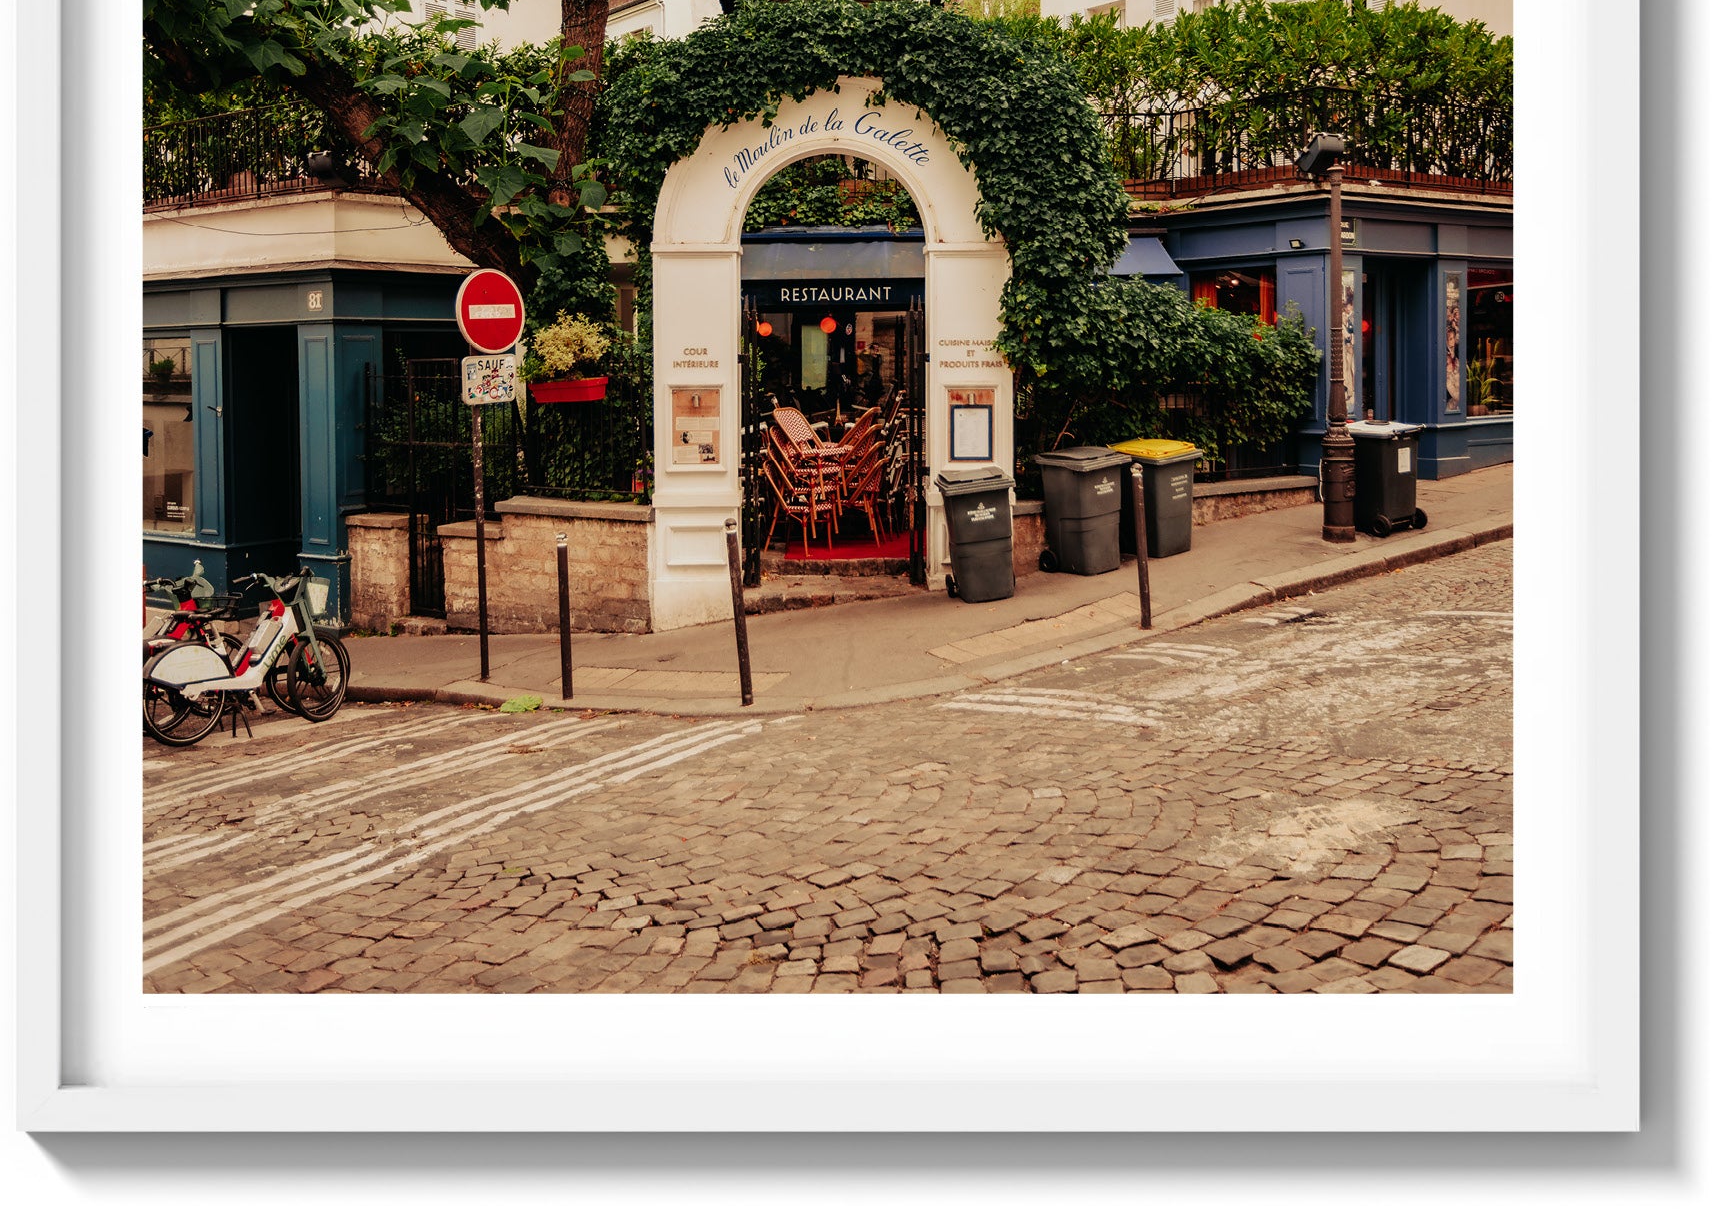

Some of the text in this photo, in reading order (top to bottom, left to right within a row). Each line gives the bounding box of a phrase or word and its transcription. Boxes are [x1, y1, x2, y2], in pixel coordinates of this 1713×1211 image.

[724, 107, 930, 189] le Moulin de la Galette
[780, 286, 892, 302] RESTAURANT
[309, 293, 322, 309] 81
[938, 339, 995, 347] CUISINE MAIS
[683, 347, 708, 356] COUR
[966, 349, 976, 357] ET
[477, 359, 505, 371] SAUF
[672, 359, 719, 369] INTÉRIEURE
[939, 360, 1003, 369] PRODUITS FRAIS
[263, 635, 287, 668] Lime
